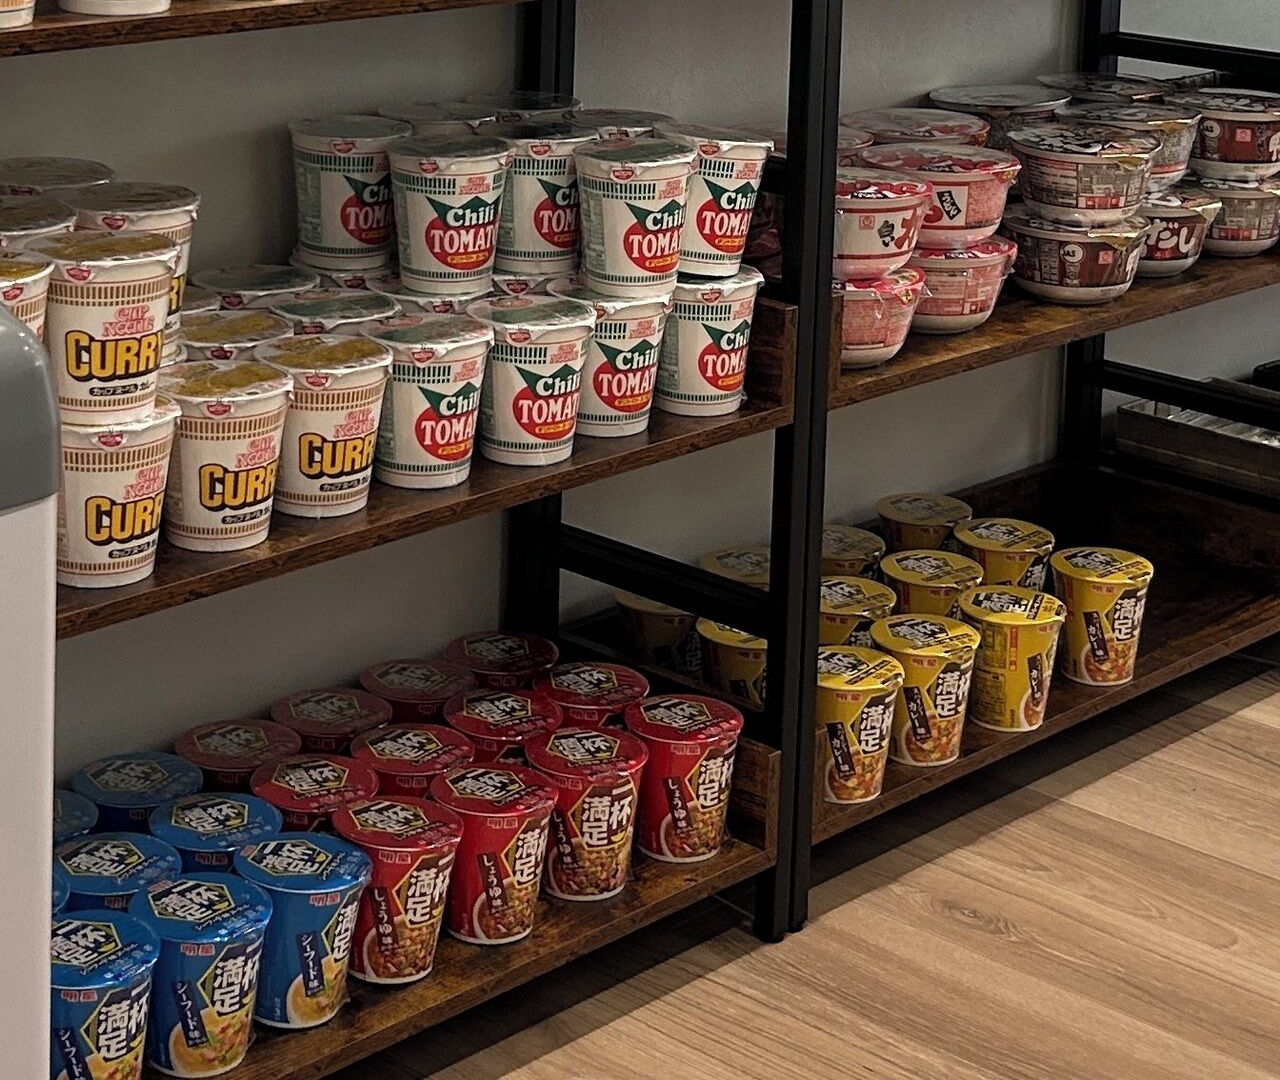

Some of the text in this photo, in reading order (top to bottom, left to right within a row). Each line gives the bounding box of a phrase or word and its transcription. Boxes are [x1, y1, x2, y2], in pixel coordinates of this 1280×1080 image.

[446, 204, 495, 227] Chili
[935, 672, 960, 717] 満足
[860, 705, 885, 753] 満足
[609, 783, 635, 831] 一杯
[698, 757, 725, 809] 満足
[581, 795, 612, 846] 満足
[513, 828, 541, 886] 満足
[406, 867, 438, 924] 満足
[332, 900, 360, 961] 満足
[212, 955, 246, 1016] 満足
[300, 934, 320, 989] シーフード味
[97, 998, 132, 1061] 満足
[176, 982, 204, 1039] シーフード味
